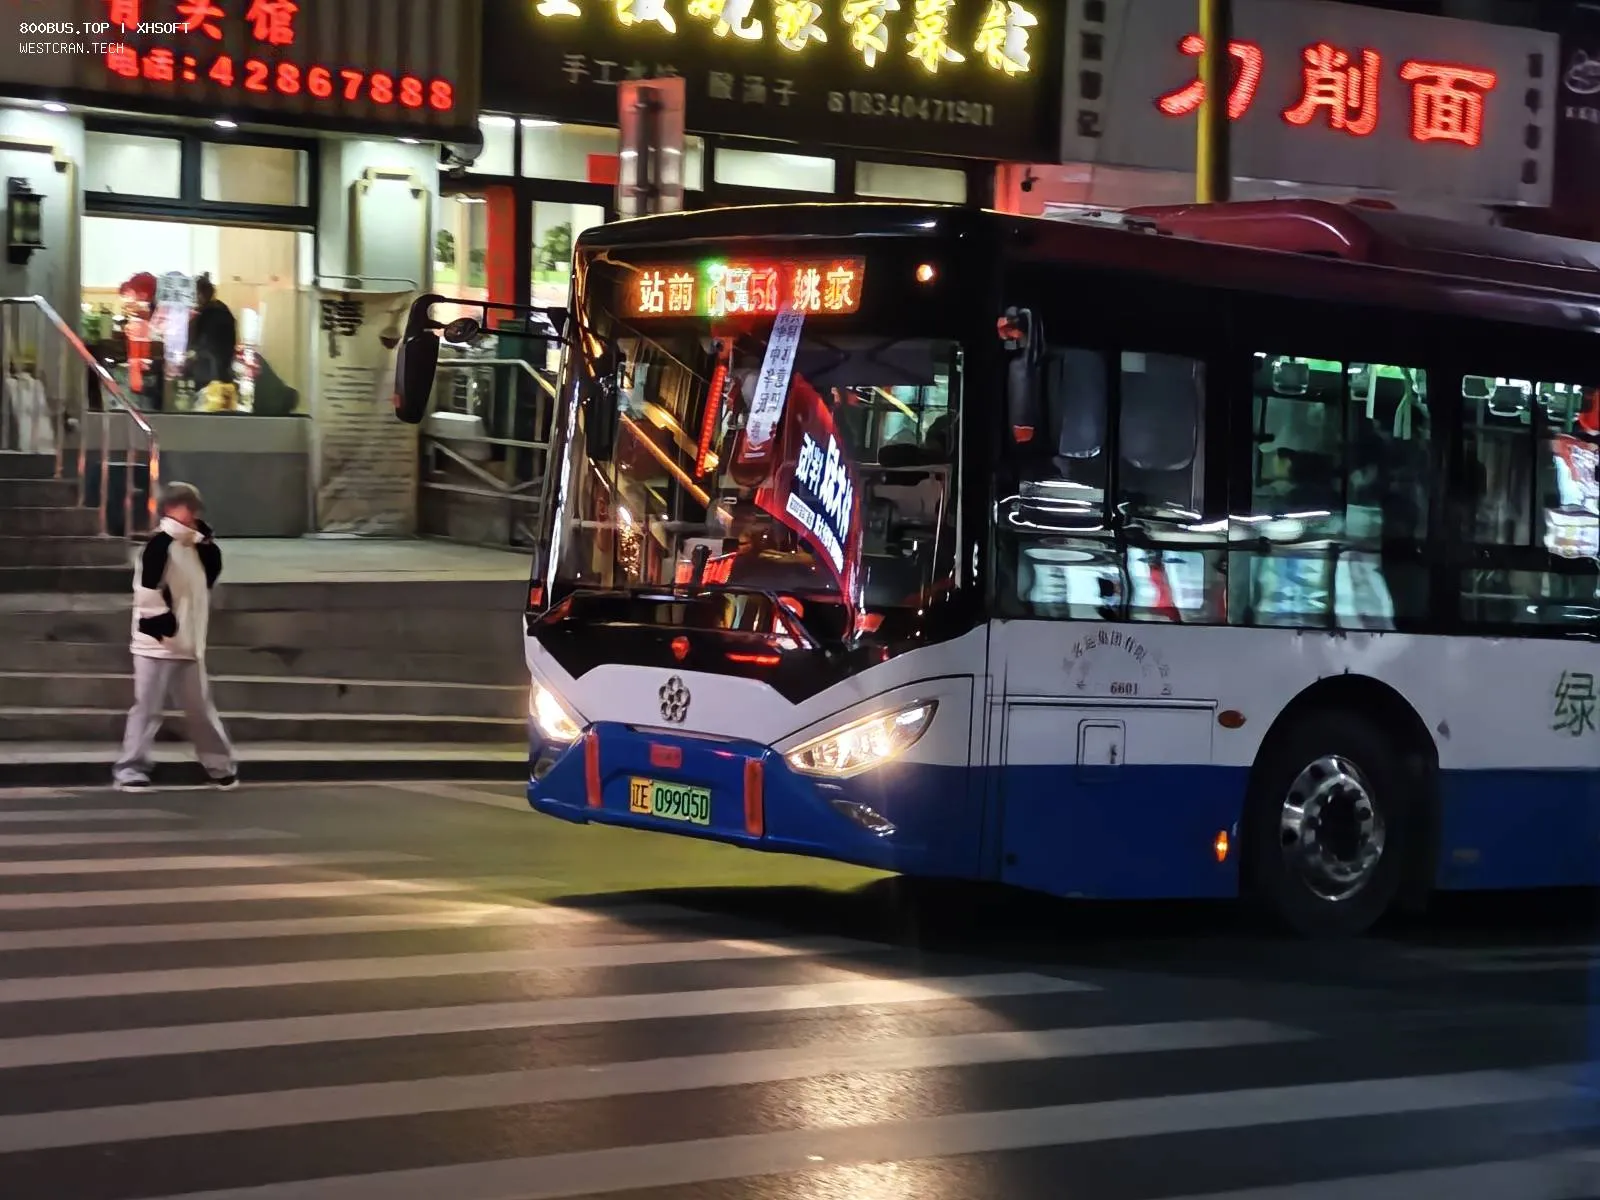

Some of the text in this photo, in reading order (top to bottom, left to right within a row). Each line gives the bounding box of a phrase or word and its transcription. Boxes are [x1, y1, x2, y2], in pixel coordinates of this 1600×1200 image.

[1157, 34, 1498, 147] 刀削面
[638, 271, 695, 313] 站前
[792, 266, 855, 312] 姚家
[1110, 681, 1139, 696] 6601
[1552, 668, 1598, 738] 绿
